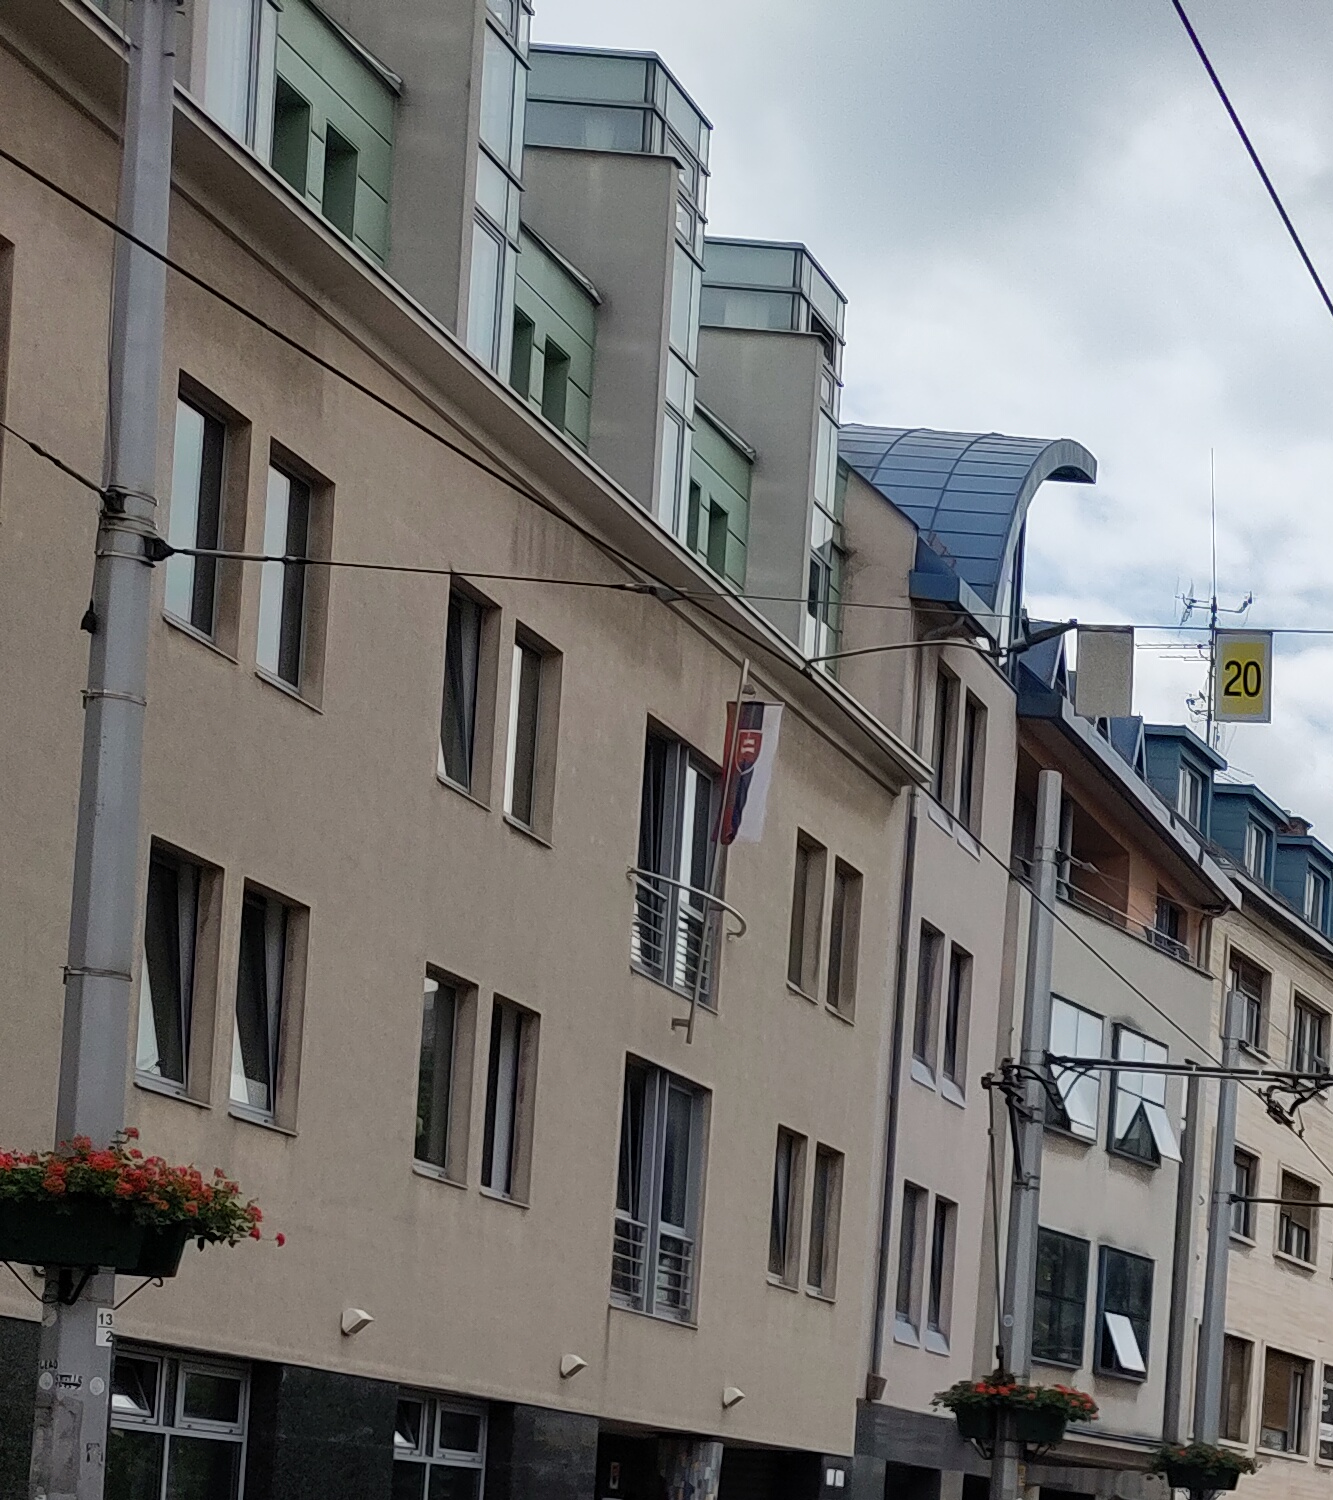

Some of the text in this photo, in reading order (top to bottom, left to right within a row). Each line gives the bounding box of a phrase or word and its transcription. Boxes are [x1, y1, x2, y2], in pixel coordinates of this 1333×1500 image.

[1224, 660, 1262, 697] 20
[99, 1313, 113, 1326] 13
[105, 1330, 114, 1343] 2
